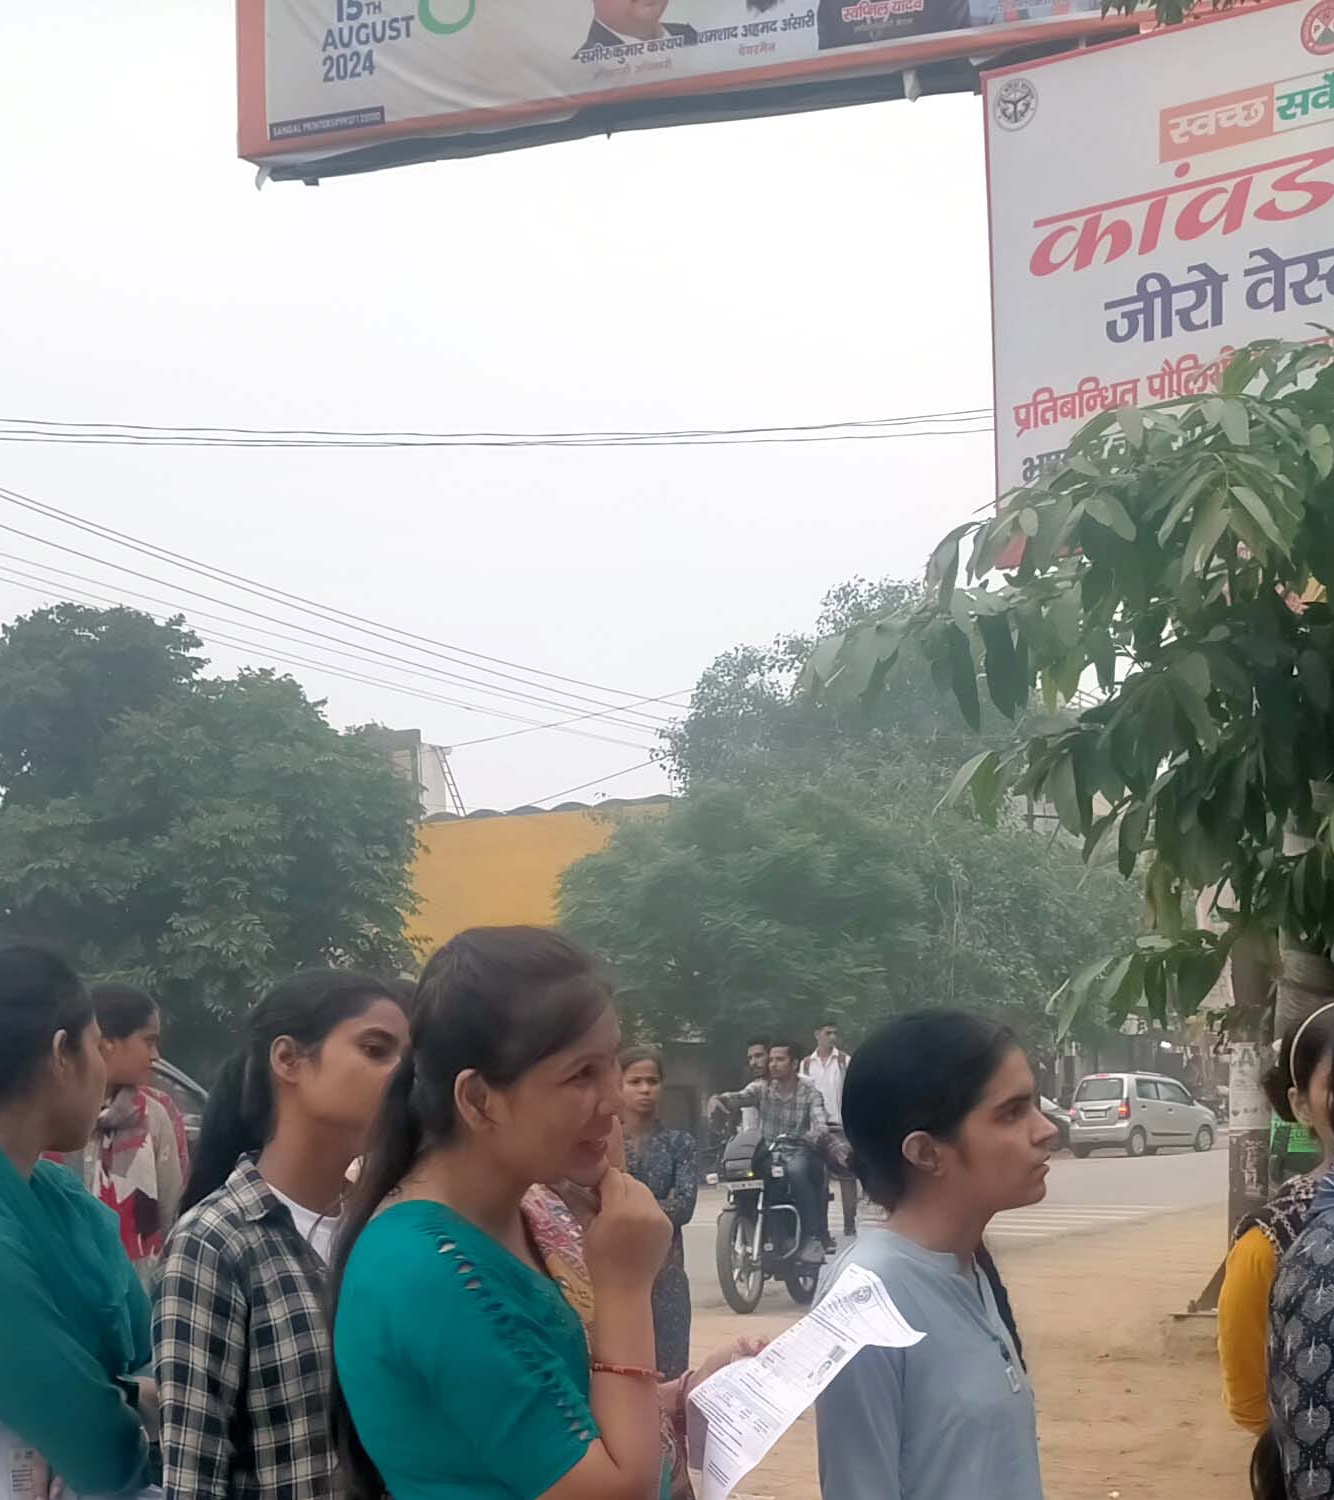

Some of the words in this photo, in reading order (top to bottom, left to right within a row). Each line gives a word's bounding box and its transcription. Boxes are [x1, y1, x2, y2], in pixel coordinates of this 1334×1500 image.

[336, 0, 382, 22] 15TH
[741, 18, 778, 38] अहमद
[781, 9, 816, 32] अंसारी
[322, 15, 415, 51] AUGUST
[322, 49, 375, 83] 2024
[579, 43, 610, 64] समीर
[612, 41, 645, 64] कुमार
[1168, 96, 1269, 145] स्वच्छ
[1104, 262, 1229, 344] जीरो
[1012, 376, 1140, 438] प्रतिबन्धित
